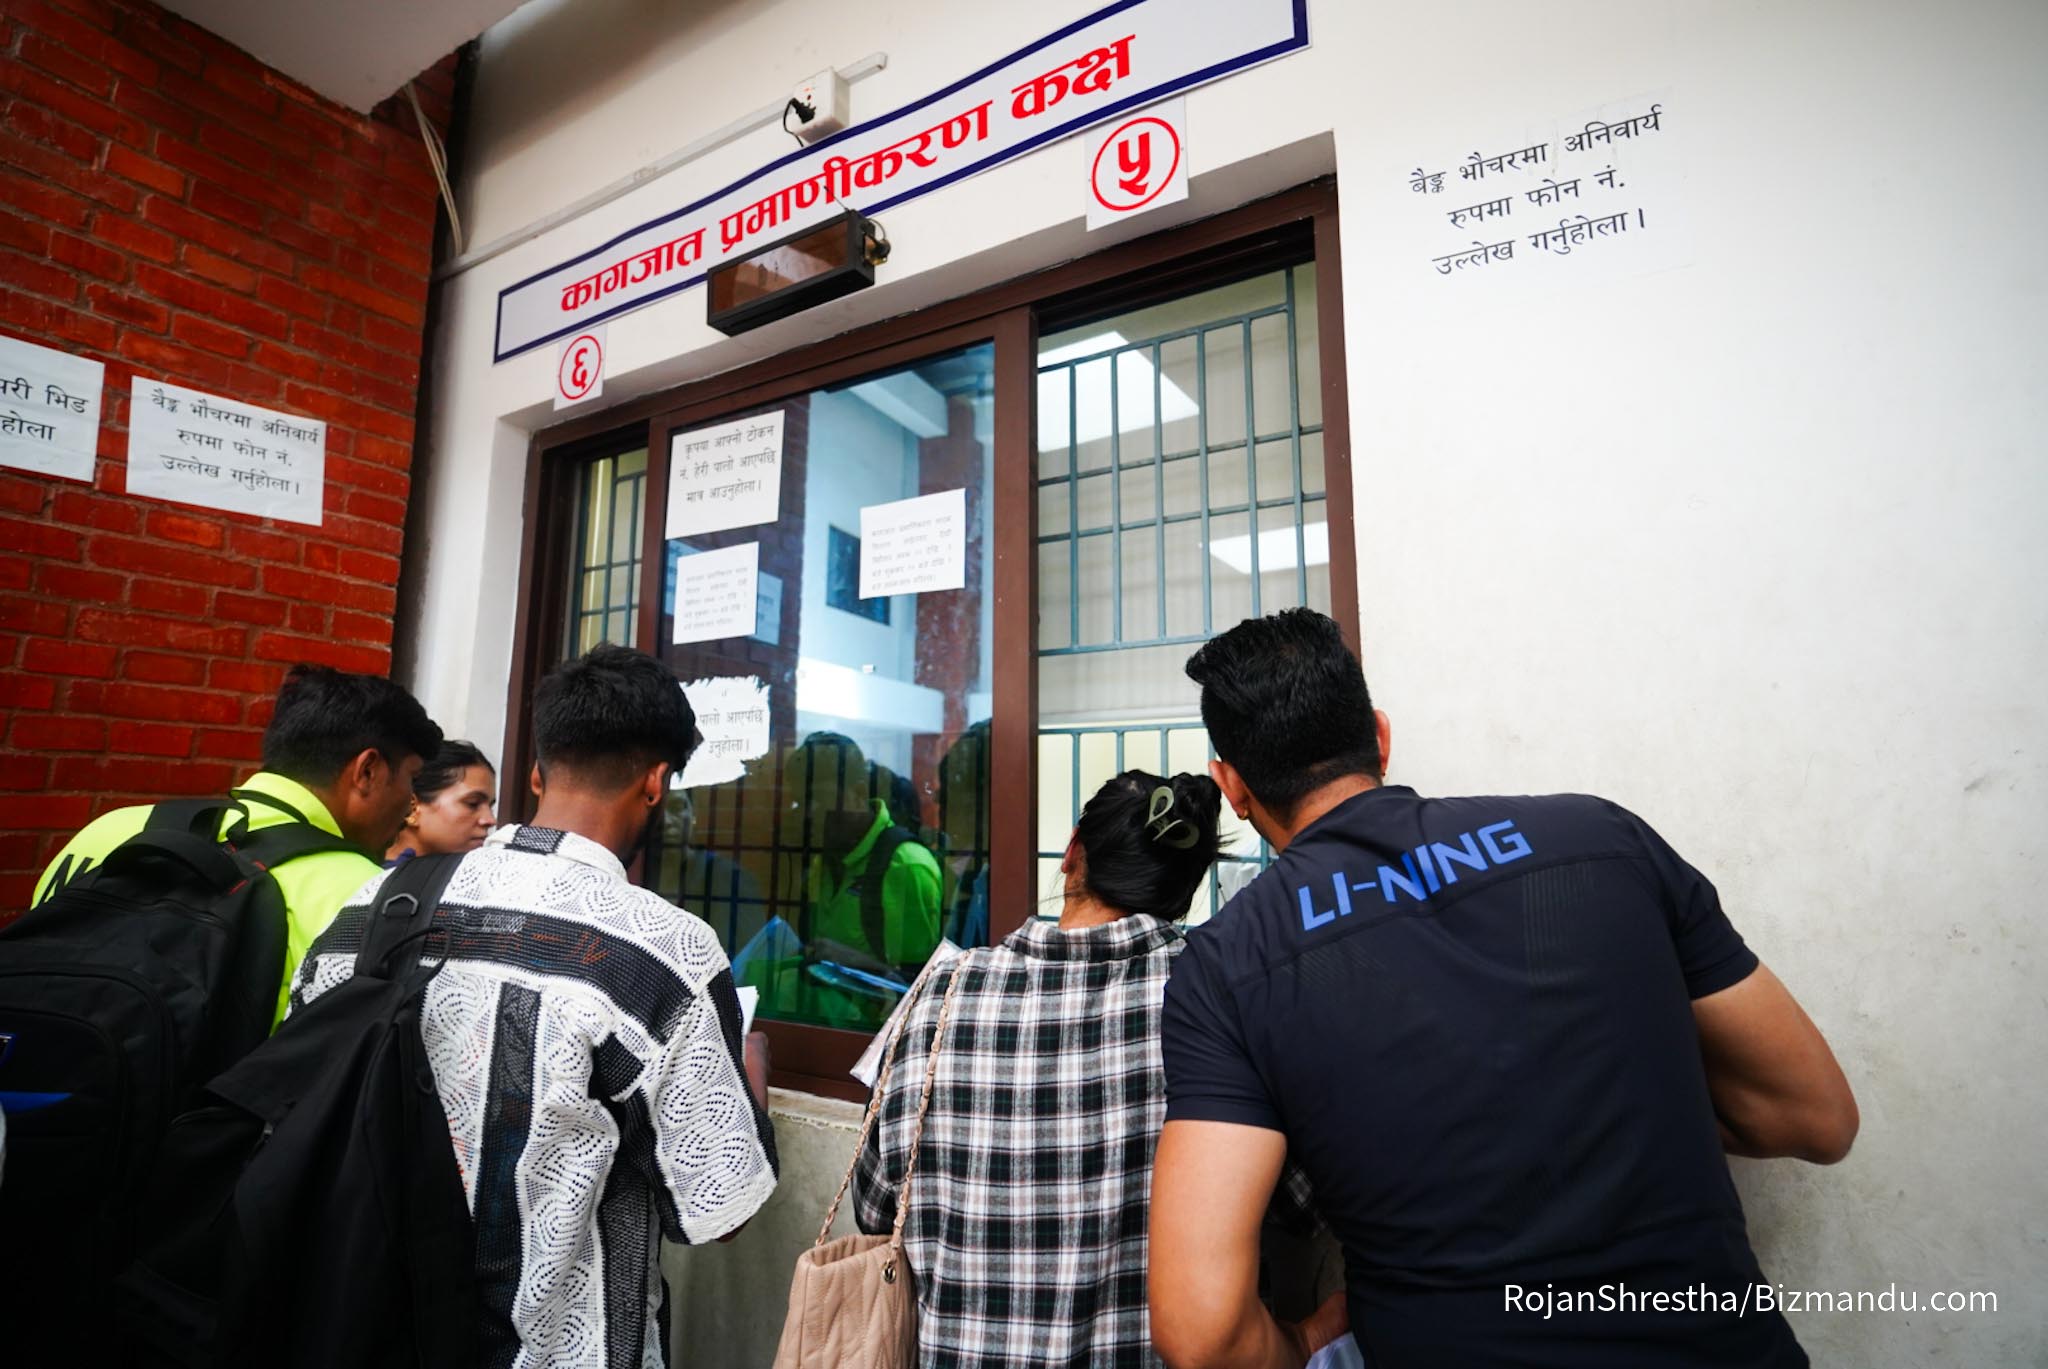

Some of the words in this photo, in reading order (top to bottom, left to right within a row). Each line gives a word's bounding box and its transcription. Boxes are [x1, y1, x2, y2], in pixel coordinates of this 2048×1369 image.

[1409, 167, 1447, 194] बैङ्क
[1459, 143, 1548, 181] भौचरमा
[1564, 104, 1662, 152] अनिवार्य
[561, 228, 706, 312] कागजात
[719, 99, 993, 254] प्रमाणीकरण
[1011, 34, 1136, 120] कक्ष
[1447, 196, 1513, 229] रुपमा
[1525, 178, 1582, 208] फोन
[1593, 164, 1625, 189] नं.
[1432, 239, 1516, 275] उल्लेख
[571, 347, 588, 391] ६
[45, 384, 90, 414] भिड
[190, 398, 252, 429] भौचरमा
[262, 418, 321, 444] अनिवार्य
[746, 425, 775, 442] टोकन
[176, 428, 224, 451] रुपमा
[232, 438, 269, 461] फोन
[713, 455, 735, 473] पालो
[740, 447, 777, 468] आएपछि
[160, 454, 221, 479] उल्लेख
[1297, 819, 1533, 931] LI-NING
